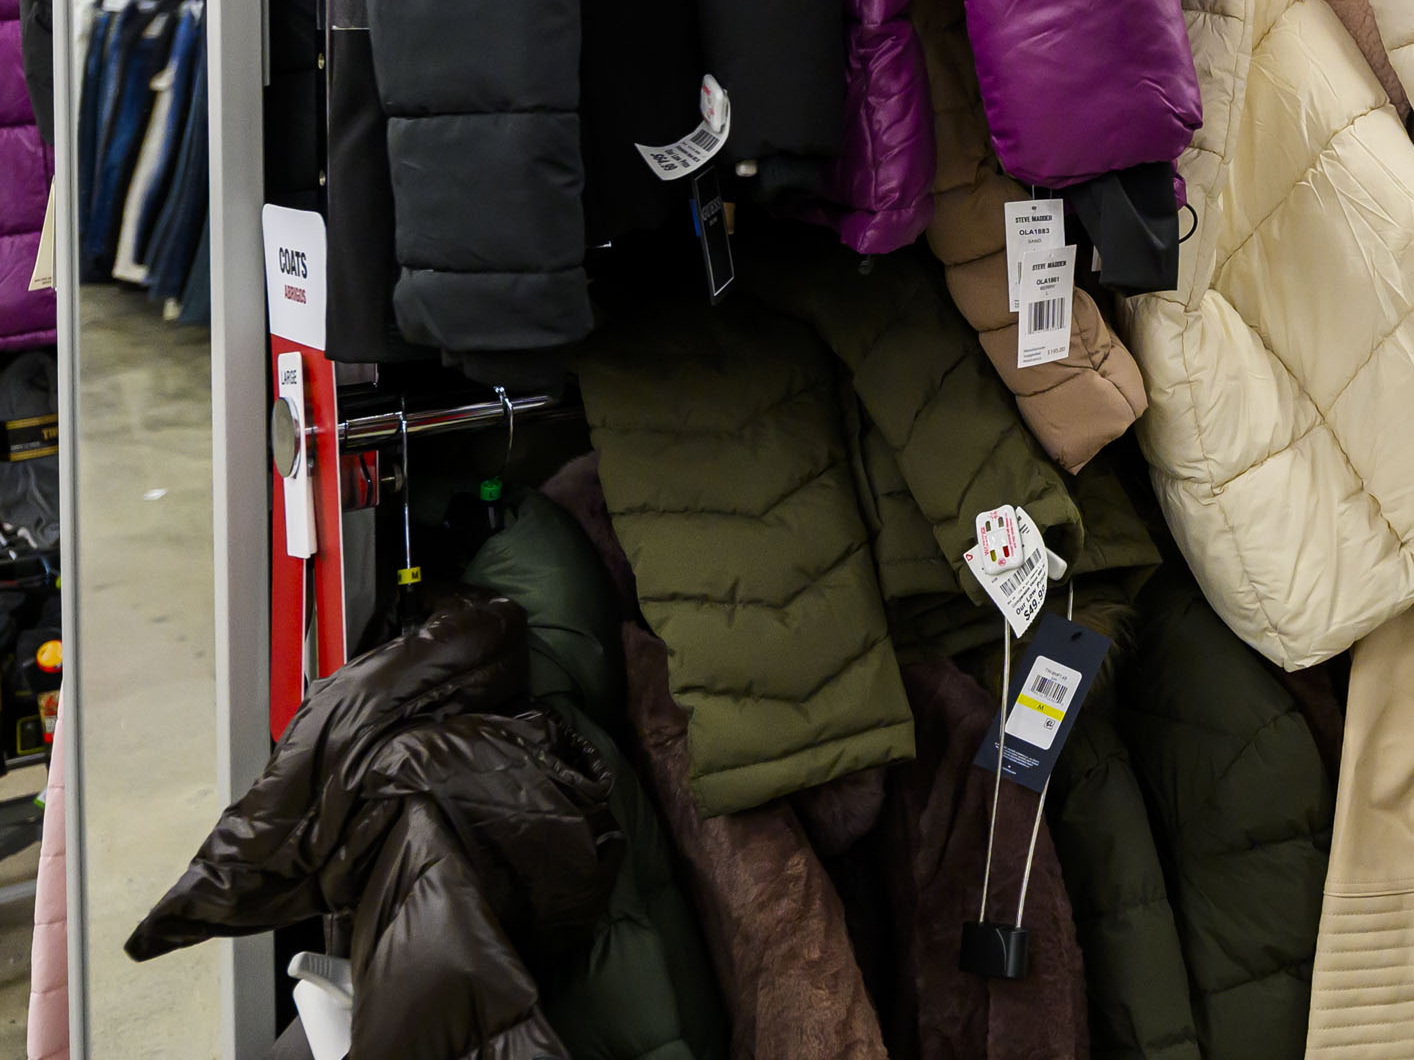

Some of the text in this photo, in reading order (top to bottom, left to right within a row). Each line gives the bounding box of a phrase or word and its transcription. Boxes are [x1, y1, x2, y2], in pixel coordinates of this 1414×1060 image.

[1015, 214, 1053, 224] STEVE MADDEN
[279, 246, 308, 279] COATS
[1032, 260, 1067, 272] STEVE MADDEN
[284, 284, 307, 304] ABRIGOS
[281, 369, 298, 386] LARGE
[411, 571, 419, 580] M
[1015, 601, 1027, 616] Our
[1026, 587, 1037, 603] Low
[1036, 703, 1045, 712] M
